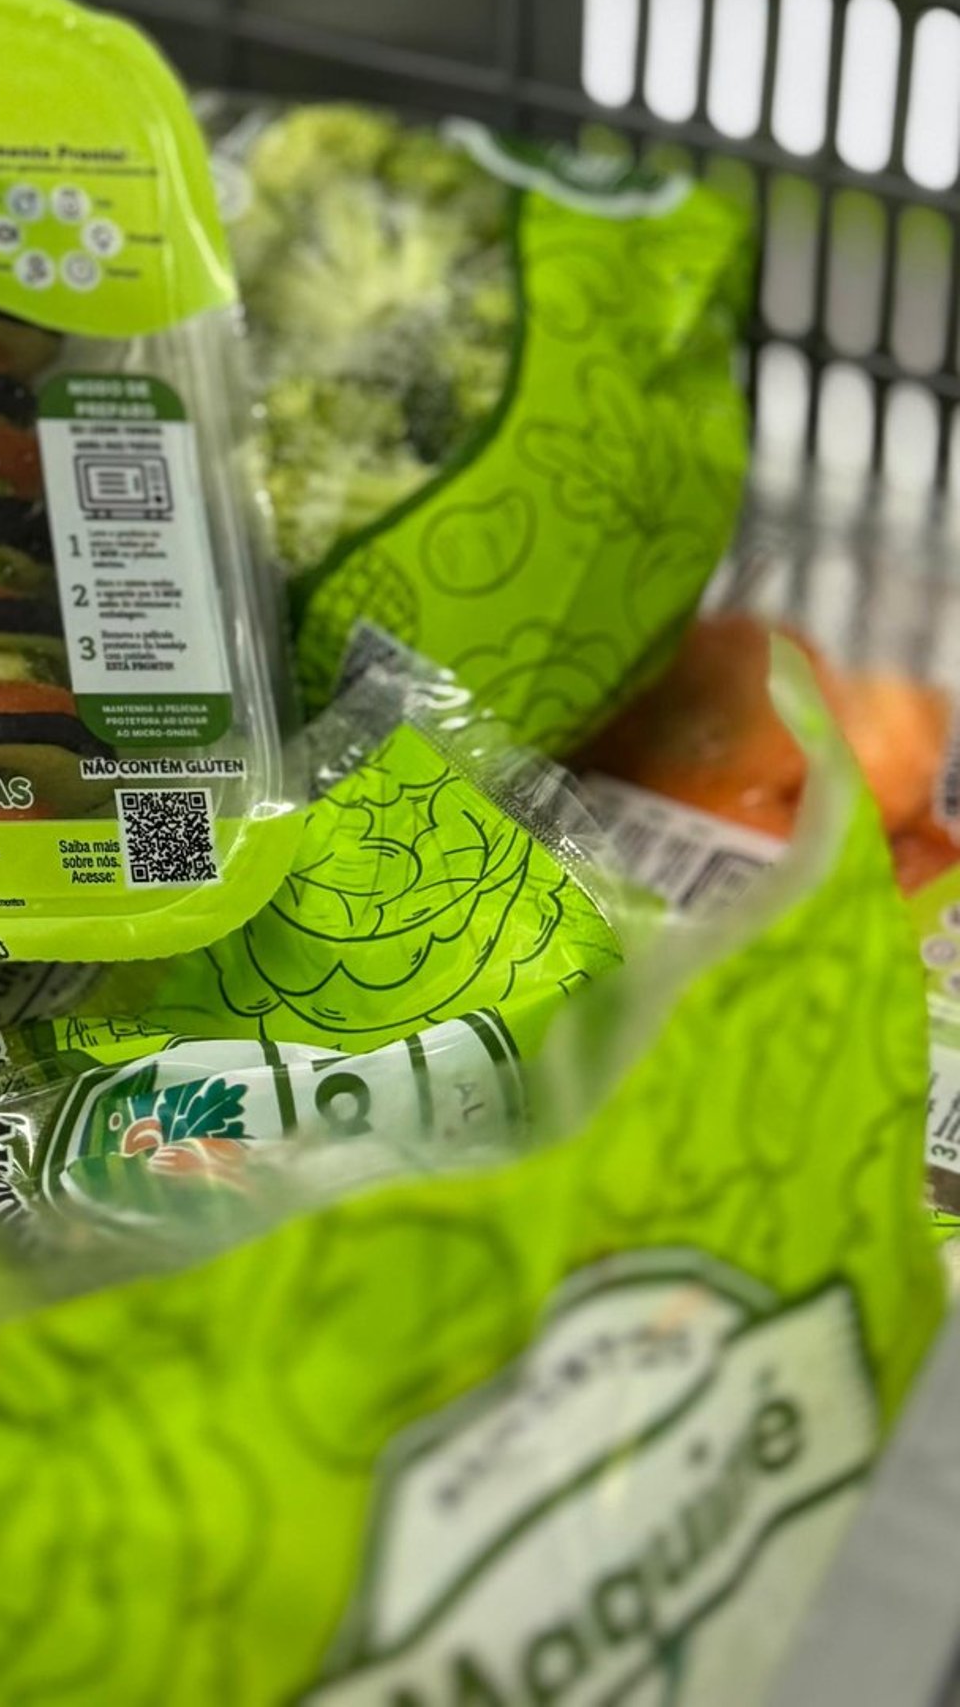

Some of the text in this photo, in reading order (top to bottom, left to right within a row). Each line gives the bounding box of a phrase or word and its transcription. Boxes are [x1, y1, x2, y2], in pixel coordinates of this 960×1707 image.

[69, 534, 82, 557] 1
[71, 584, 90, 608] 2
[78, 635, 97, 661] 3
[102, 705, 154, 714] MANTENHA
[116, 729, 130, 738] AO
[82, 757, 244, 775] NÃO CONTÉM GLÚTEN
[59, 839, 121, 853] Saiba mais
[62, 854, 122, 868] sobre nós.
[71, 870, 116, 884] Acesse:
